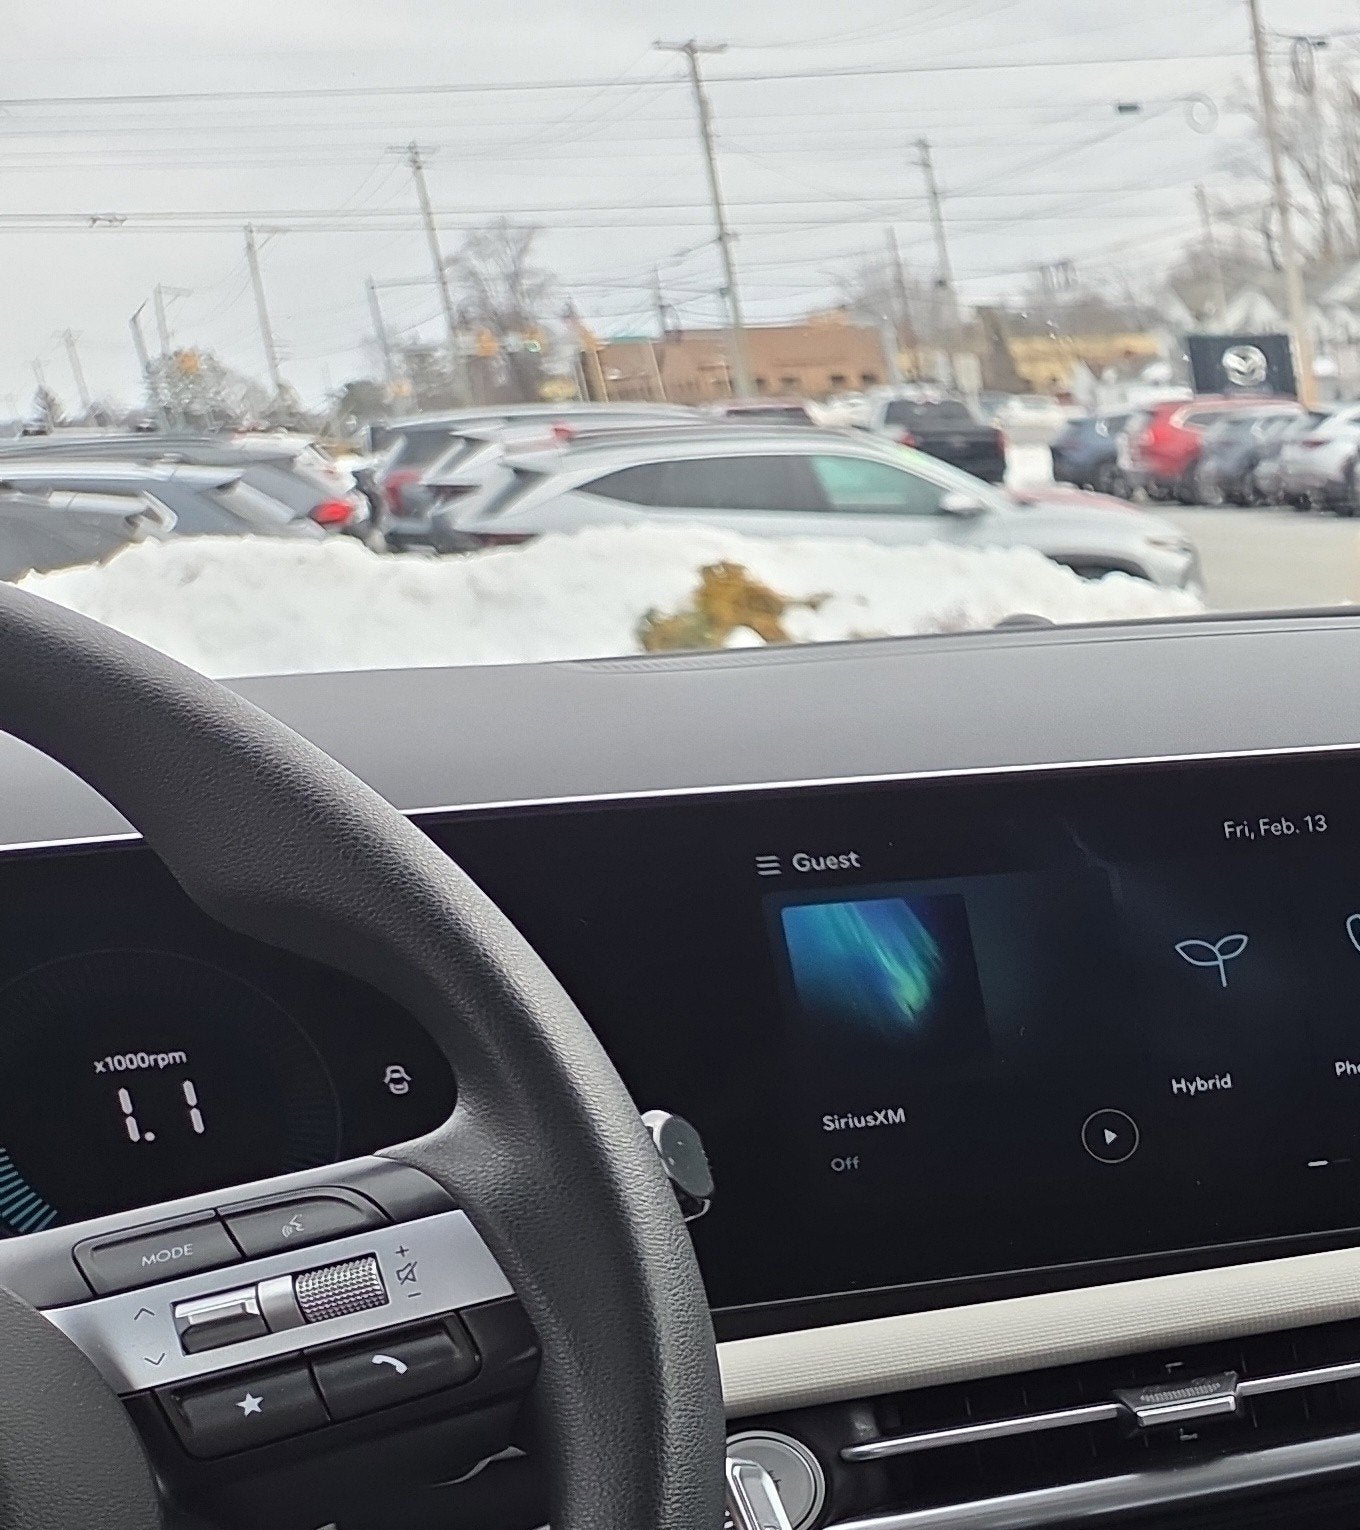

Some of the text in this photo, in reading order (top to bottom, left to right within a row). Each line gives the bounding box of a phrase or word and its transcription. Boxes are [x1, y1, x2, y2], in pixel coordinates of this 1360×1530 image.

[1223, 814, 1328, 840] Fri, Feb. 13
[792, 851, 861, 873] Guest
[93, 1051, 188, 1074] x1000rpm
[1171, 1073, 1232, 1096] Hybrid
[117, 1080, 205, 1143] 1.1
[822, 1107, 906, 1132] SiriusXM
[830, 1155, 860, 1172] Off
[141, 1243, 193, 1267] MODE
